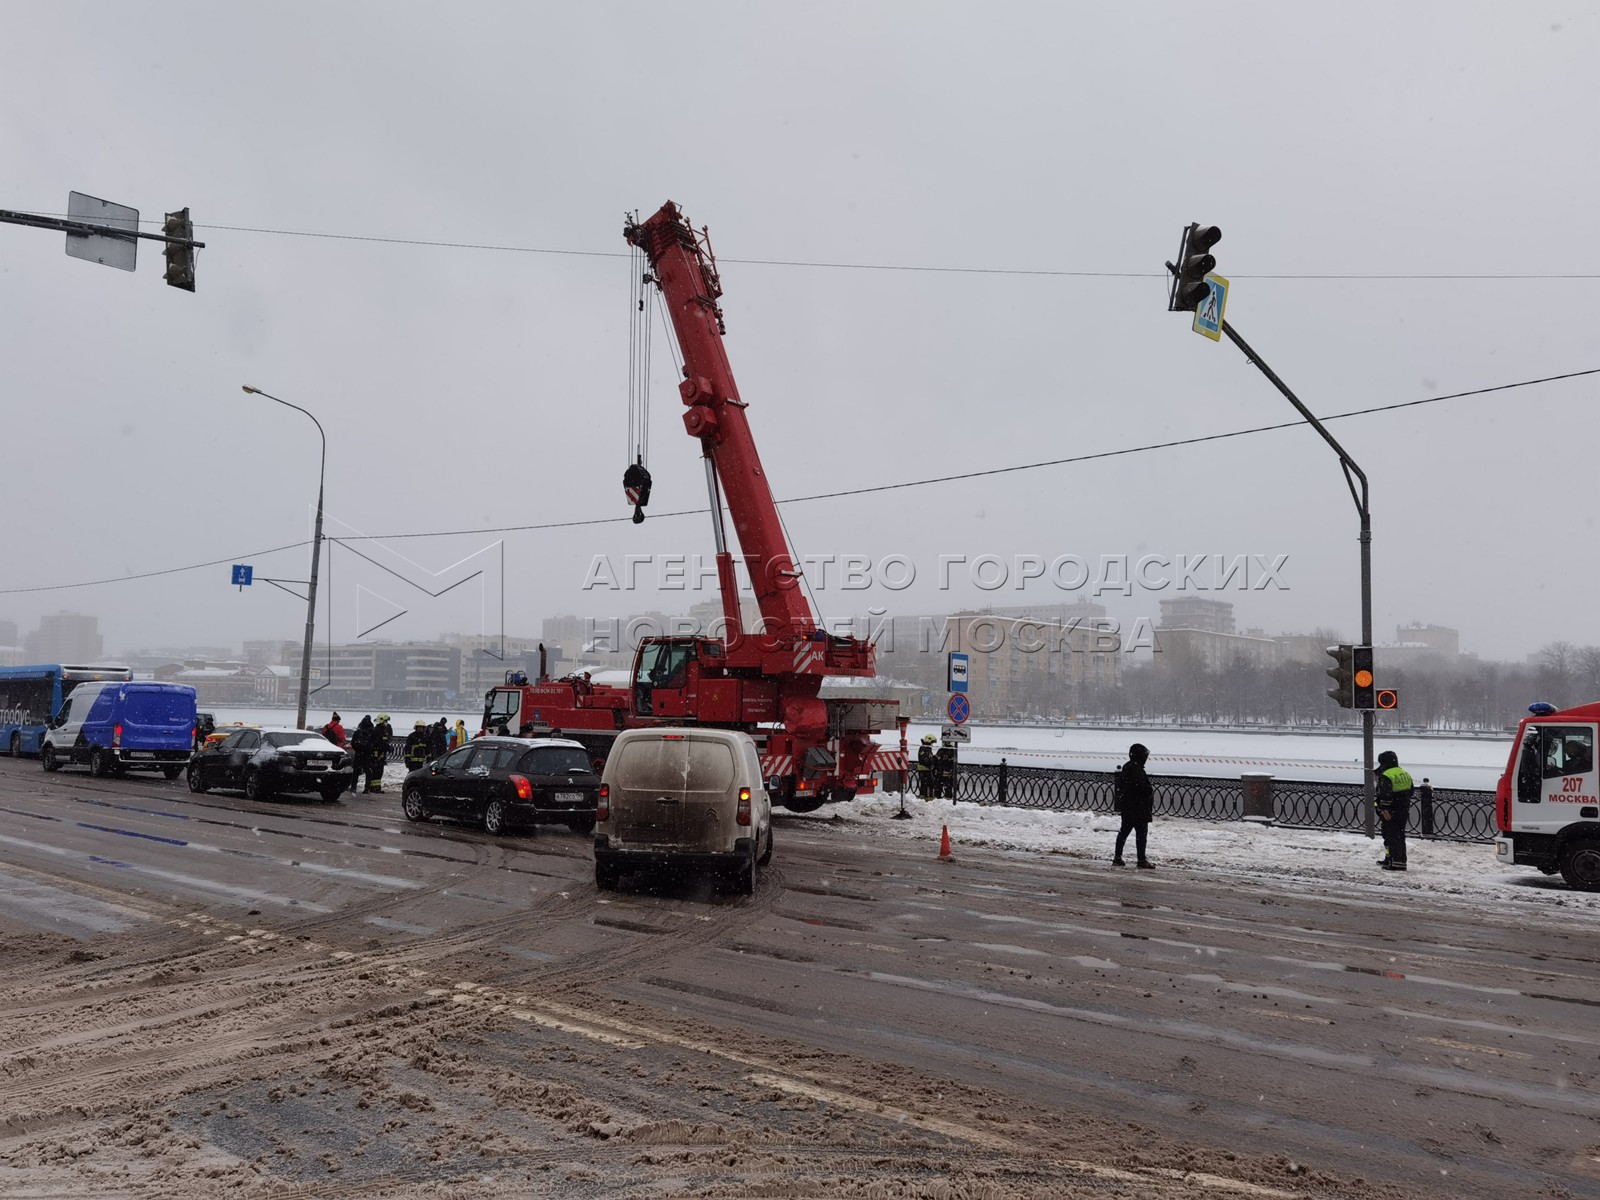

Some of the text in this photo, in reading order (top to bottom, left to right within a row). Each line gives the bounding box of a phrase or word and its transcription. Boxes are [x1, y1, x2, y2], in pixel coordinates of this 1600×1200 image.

[811, 651, 824, 660] АК
[1562, 777, 1583, 792] 207
[1548, 794, 1598, 804] МОСКВА
